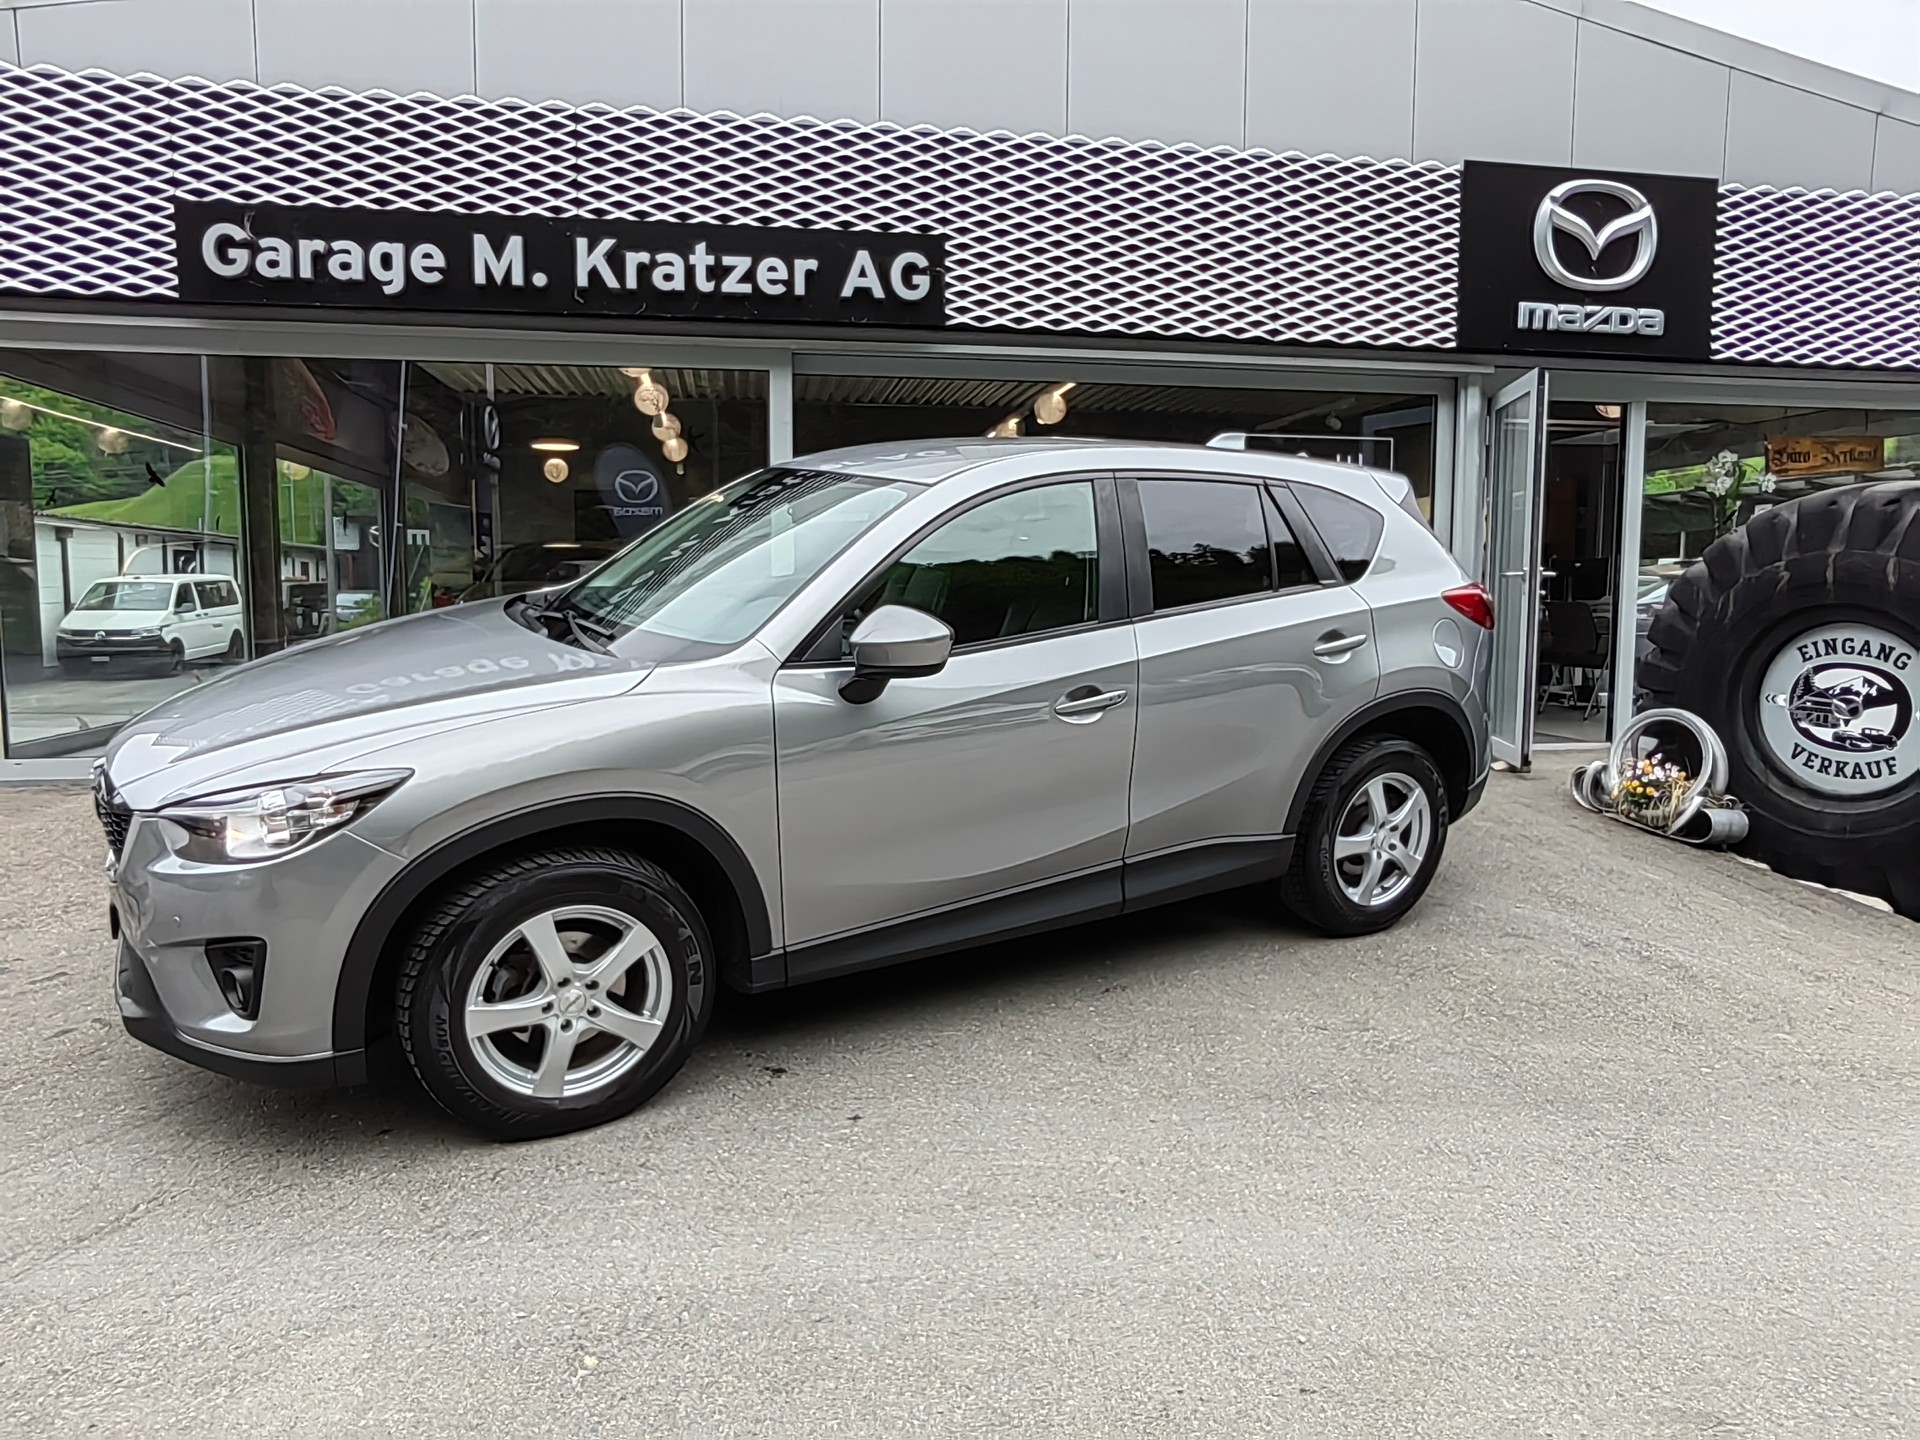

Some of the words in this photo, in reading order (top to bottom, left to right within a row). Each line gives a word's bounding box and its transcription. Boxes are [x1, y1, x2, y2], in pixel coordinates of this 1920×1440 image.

[202, 222, 447, 296] Garage
[472, 233, 550, 288] M.
[575, 236, 819, 295] Kratzer
[840, 250, 932, 301] AG
[1517, 301, 1665, 336] mazda
[1797, 637, 1913, 671] EINGANG
[1790, 742, 1898, 780] VERKAUF
